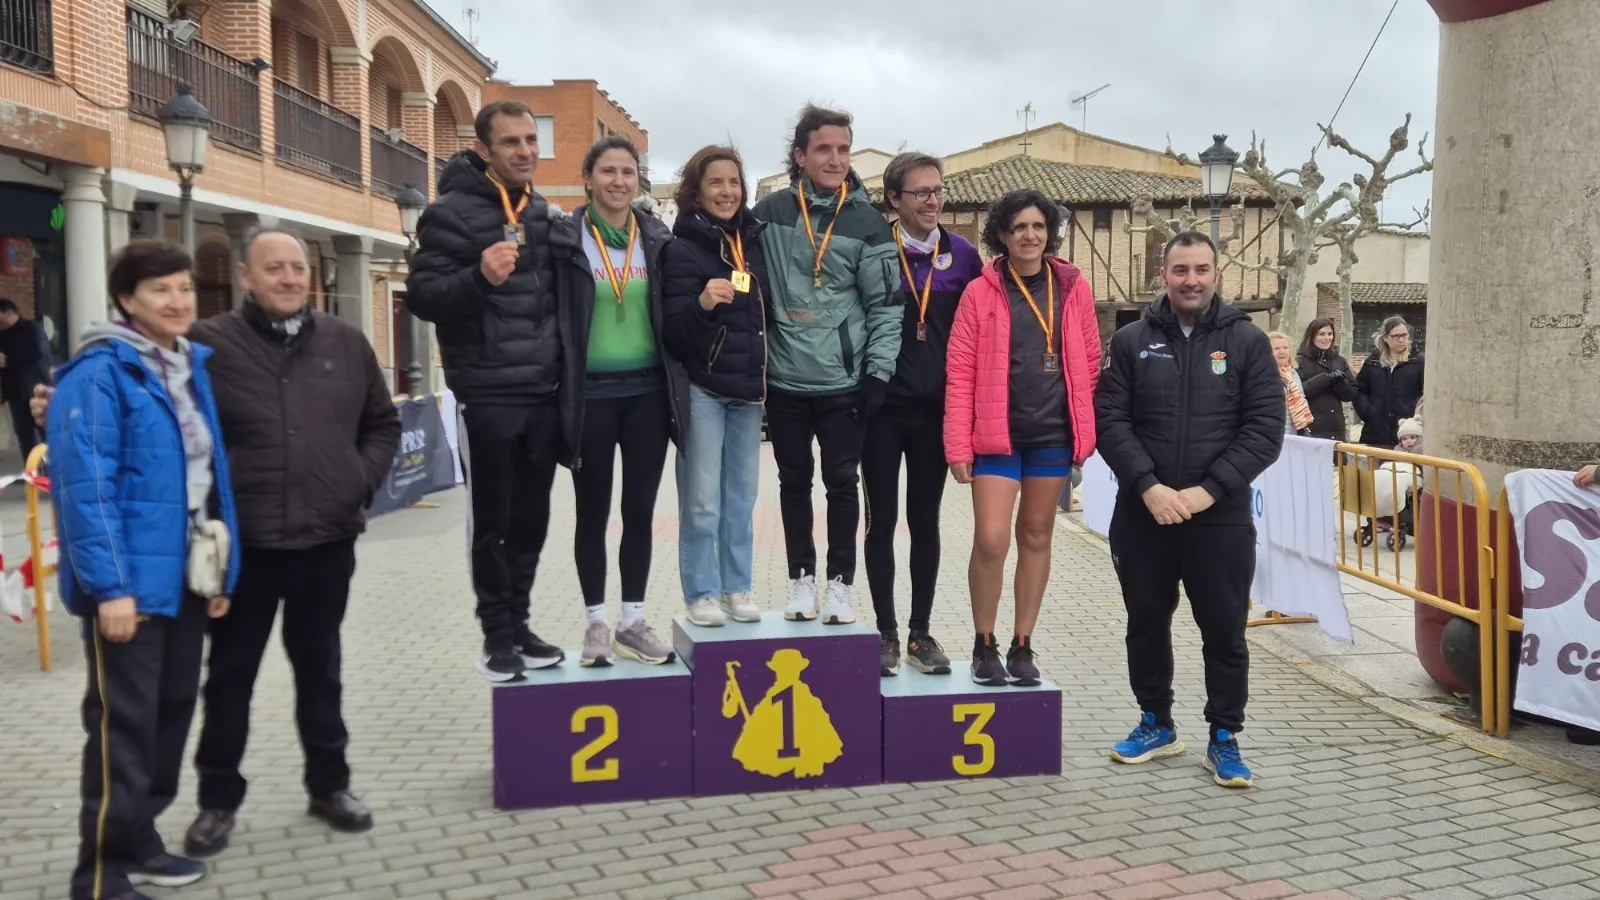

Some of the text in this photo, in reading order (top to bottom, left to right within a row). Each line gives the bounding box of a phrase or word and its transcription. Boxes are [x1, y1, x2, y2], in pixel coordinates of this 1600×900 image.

[571, 704, 619, 783] 2
[771, 684, 801, 759] 1
[952, 702, 996, 776] 3
